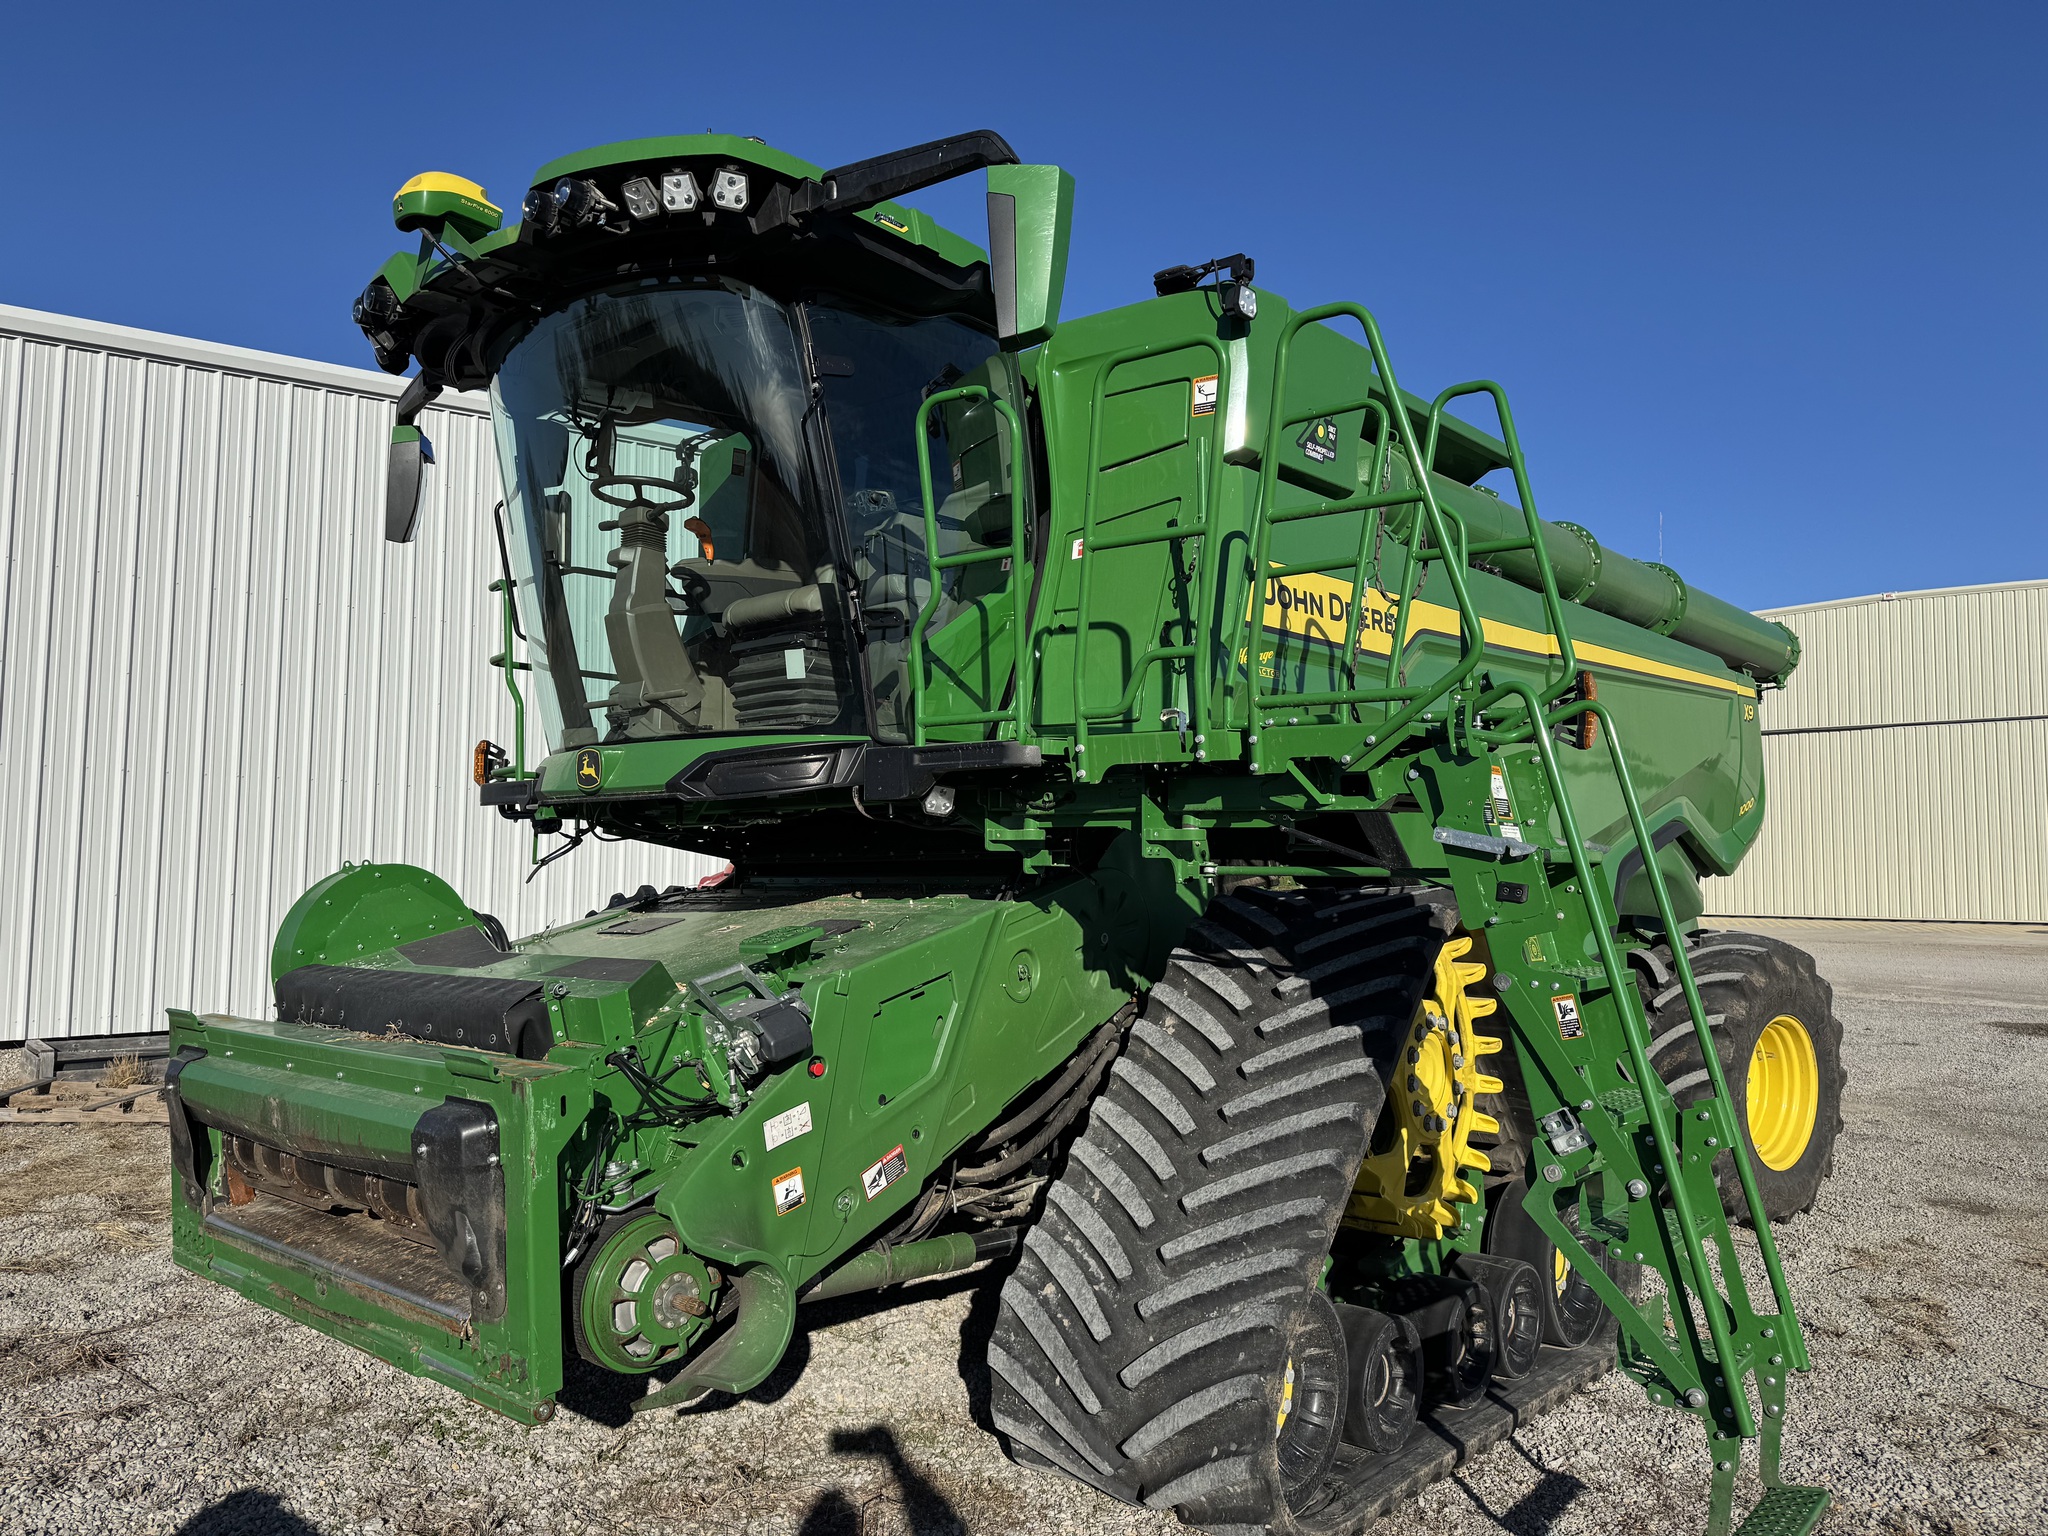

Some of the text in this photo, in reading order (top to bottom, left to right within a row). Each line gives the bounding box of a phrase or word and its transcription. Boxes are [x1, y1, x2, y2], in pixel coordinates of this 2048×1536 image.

[461, 198, 483, 211] StarFire
[1306, 441, 1335, 459] SELF-PROPELLED
[1264, 578, 1324, 618] JOHN
[1743, 703, 1755, 722] X9
[1739, 797, 1754, 816] 1000
